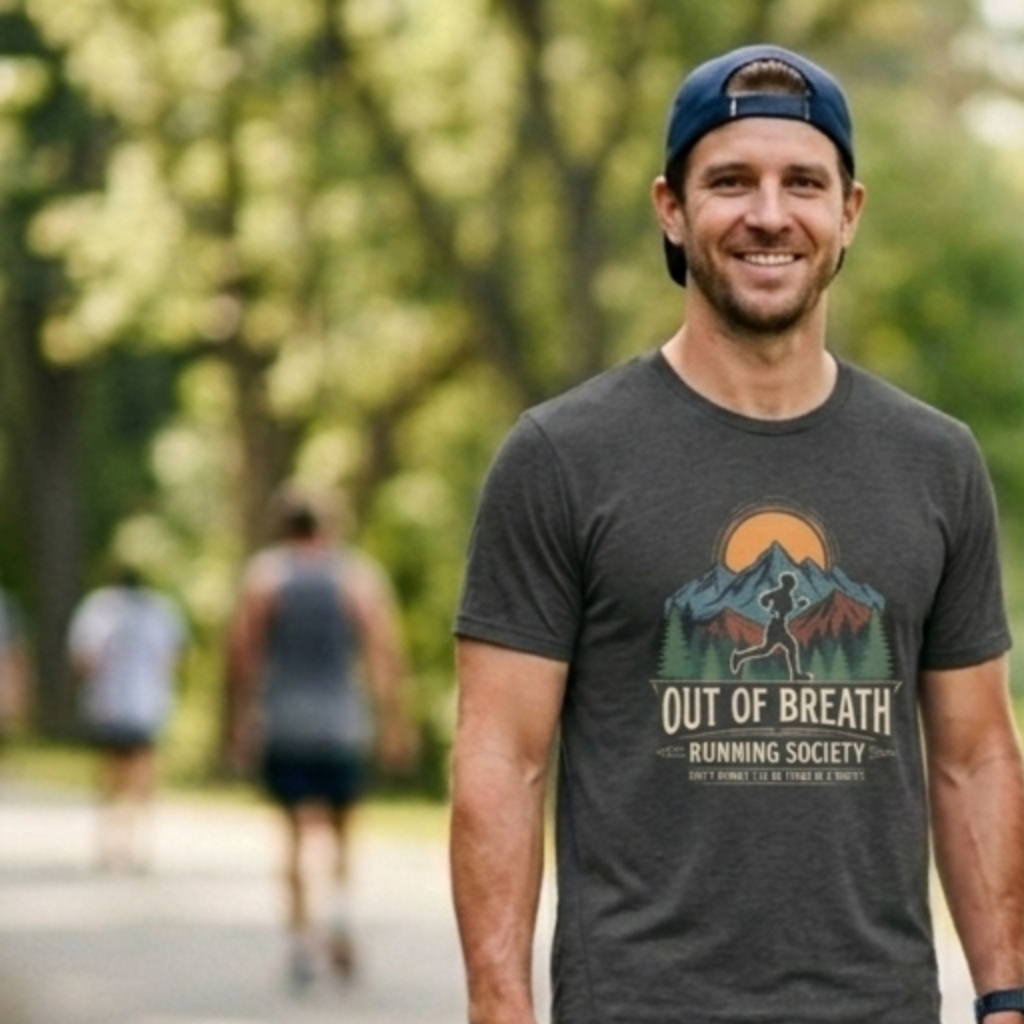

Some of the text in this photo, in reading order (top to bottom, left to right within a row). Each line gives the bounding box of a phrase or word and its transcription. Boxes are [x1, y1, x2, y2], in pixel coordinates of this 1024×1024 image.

[662, 686, 891, 736] OUT OF BREATH
[689, 741, 865, 763] RUNNING SOCIETY
